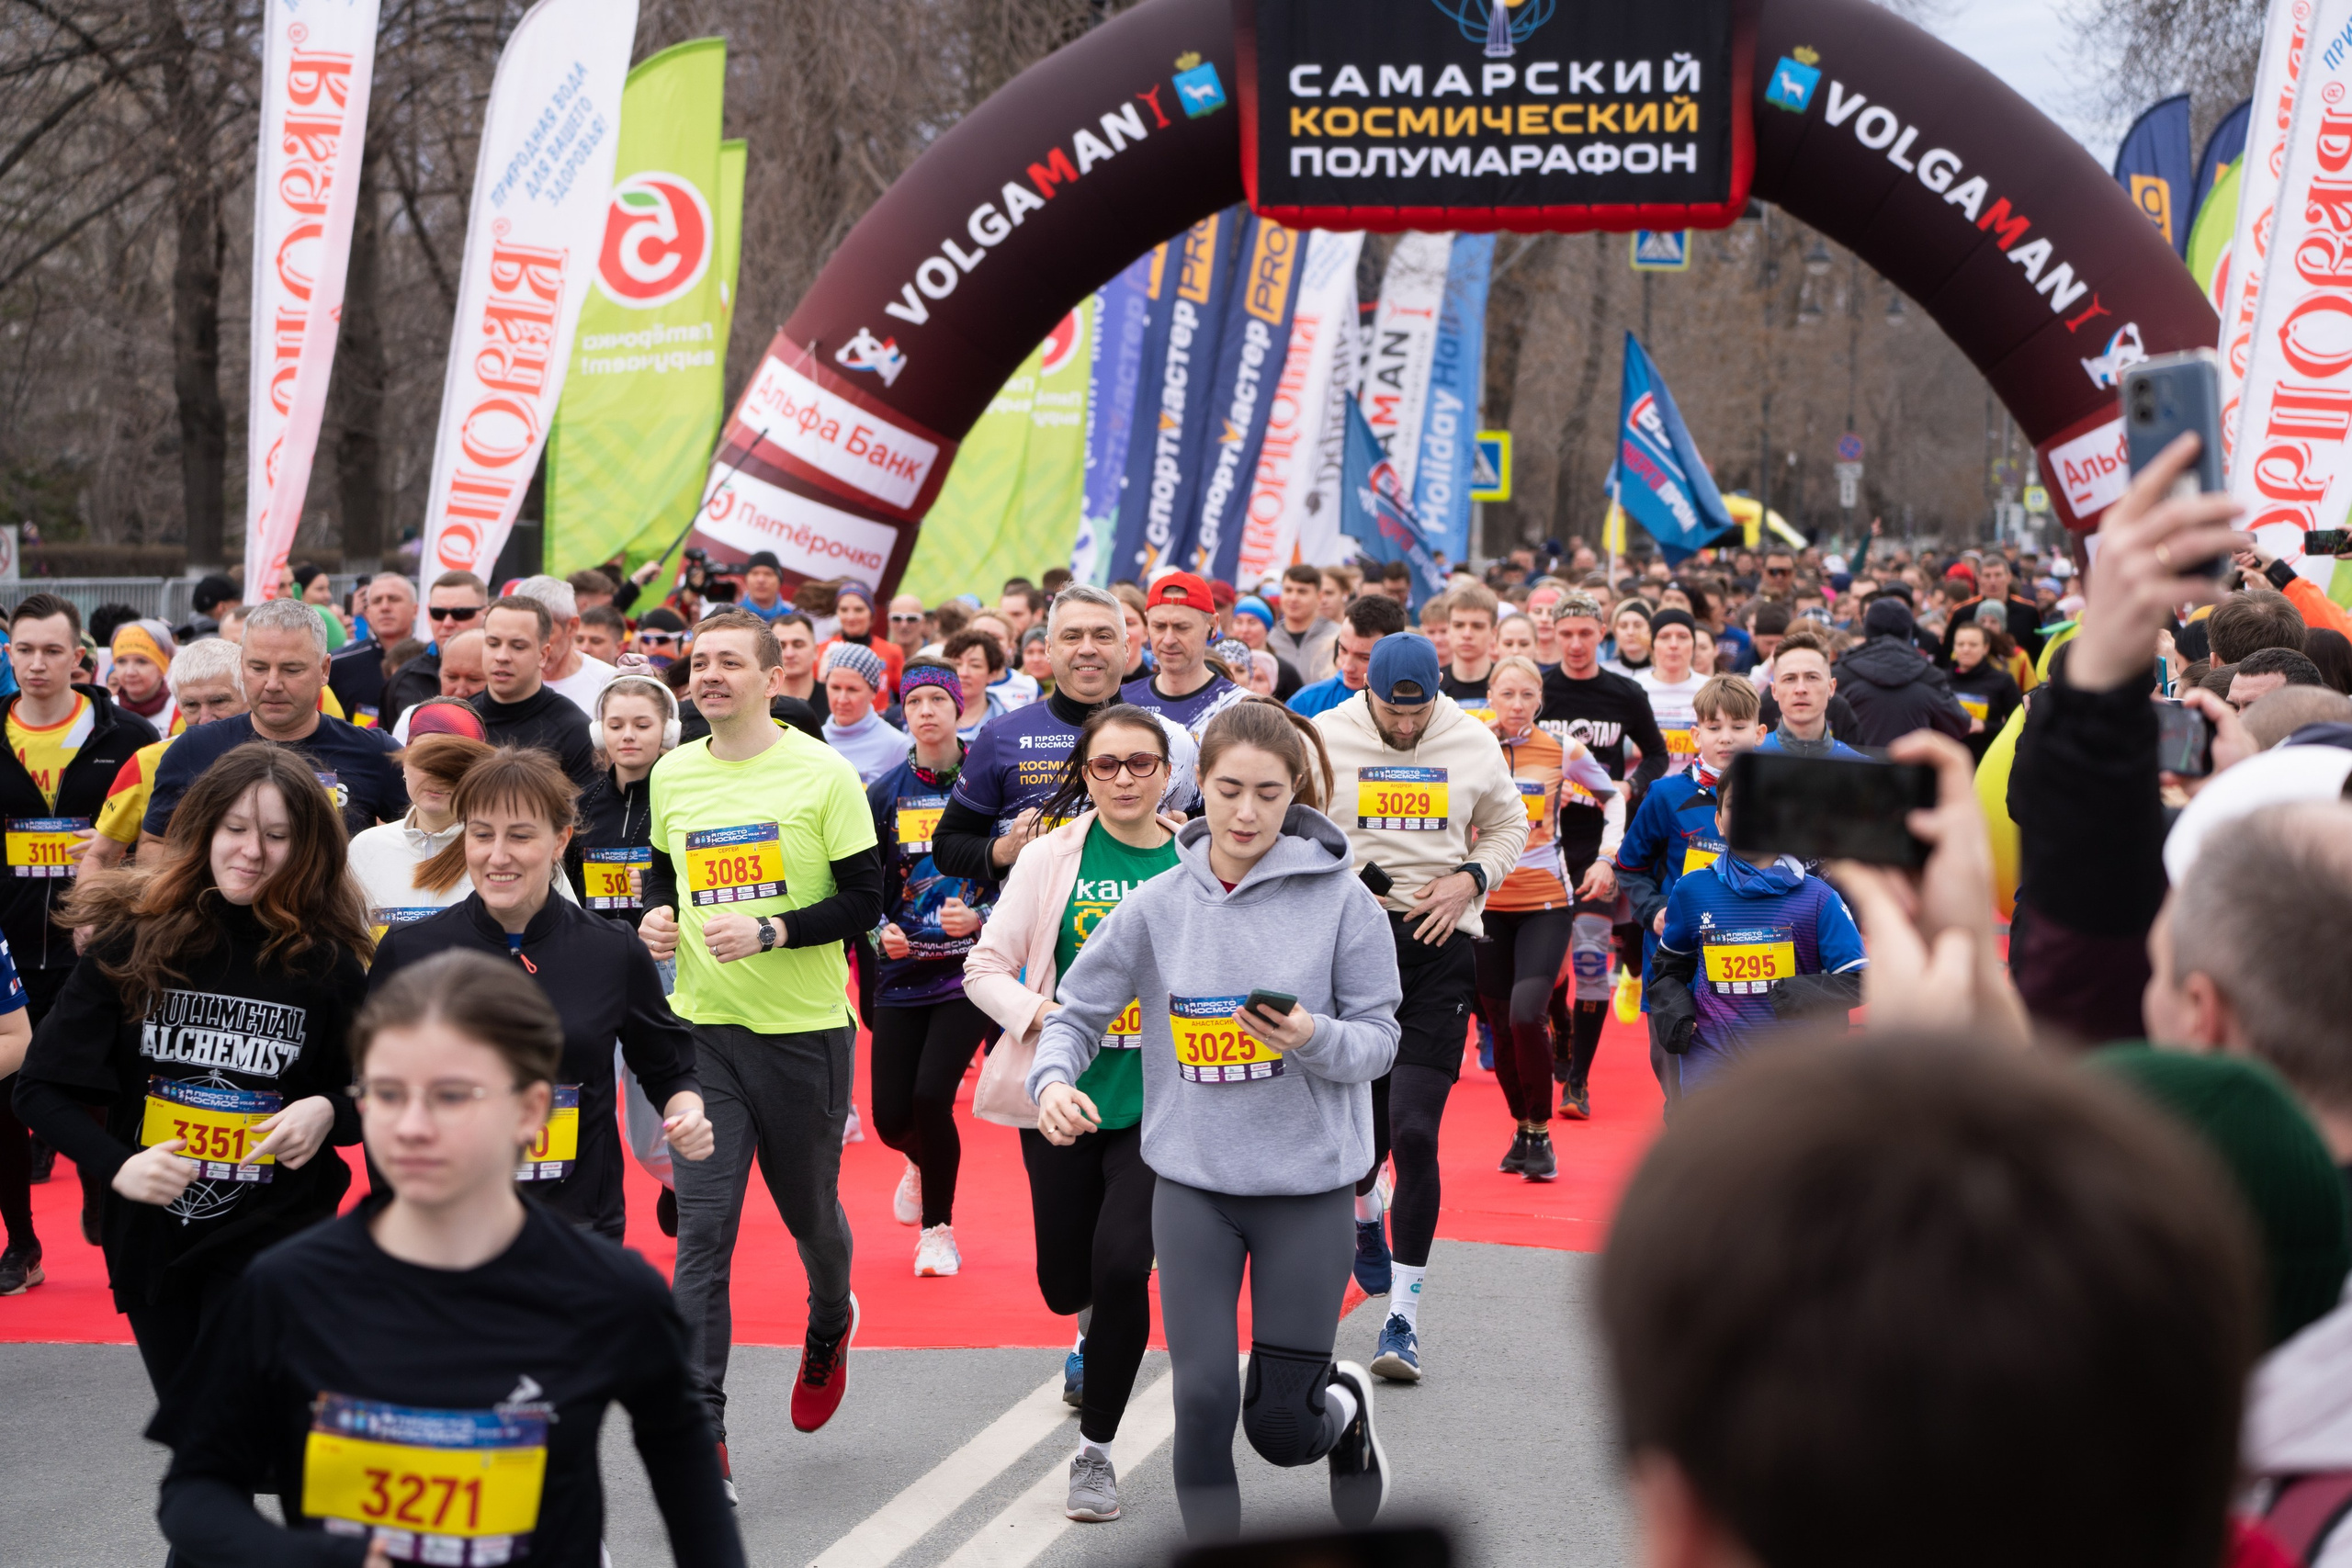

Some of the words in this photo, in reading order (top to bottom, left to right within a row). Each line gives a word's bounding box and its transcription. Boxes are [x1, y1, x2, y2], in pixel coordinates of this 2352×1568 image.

[1289, 53, 1701, 97] САМАРСКИЙ
[490, 107, 559, 209] ПРИРОДНАЯ
[552, 61, 588, 110] ВОДА
[1290, 96, 1699, 138] КОСМИЧЕСКИЙ
[526, 159, 551, 200] ДЛЯ
[1290, 142, 1697, 177] ПОЛУМАРАФОН
[886, 102, 1148, 326] VOLGAMAN
[1824, 80, 2087, 314] VOLGAMAN
[1198, 321, 1272, 549] спортмастер
[1251, 226, 1289, 314] PRO
[757, 373, 840, 443] Альфа
[844, 425, 924, 484] Банк
[1145, 299, 1199, 546] спортмастер
[1419, 389, 1464, 533] Holiday
[737, 502, 883, 570] Пятёрочка
[1020, 736, 1032, 749] Я
[1035, 734, 1075, 742] ПРОСТО
[1376, 793, 1430, 815] 3029
[28, 842, 66, 863] 3111
[711, 834, 748, 843] КОСМОС
[705, 854, 763, 886] 3083
[1721, 954, 1776, 979] 3295
[1190, 1006, 1237, 1014] КОСМОС
[141, 1024, 301, 1078] ALCHEMIST
[1184, 1032, 1256, 1063] 3025
[185, 1095, 239, 1108] КОСМОС
[194, 1091, 240, 1101] ПРОСТО
[173, 1119, 245, 1159] 3351
[360, 1468, 483, 1531] 3271
